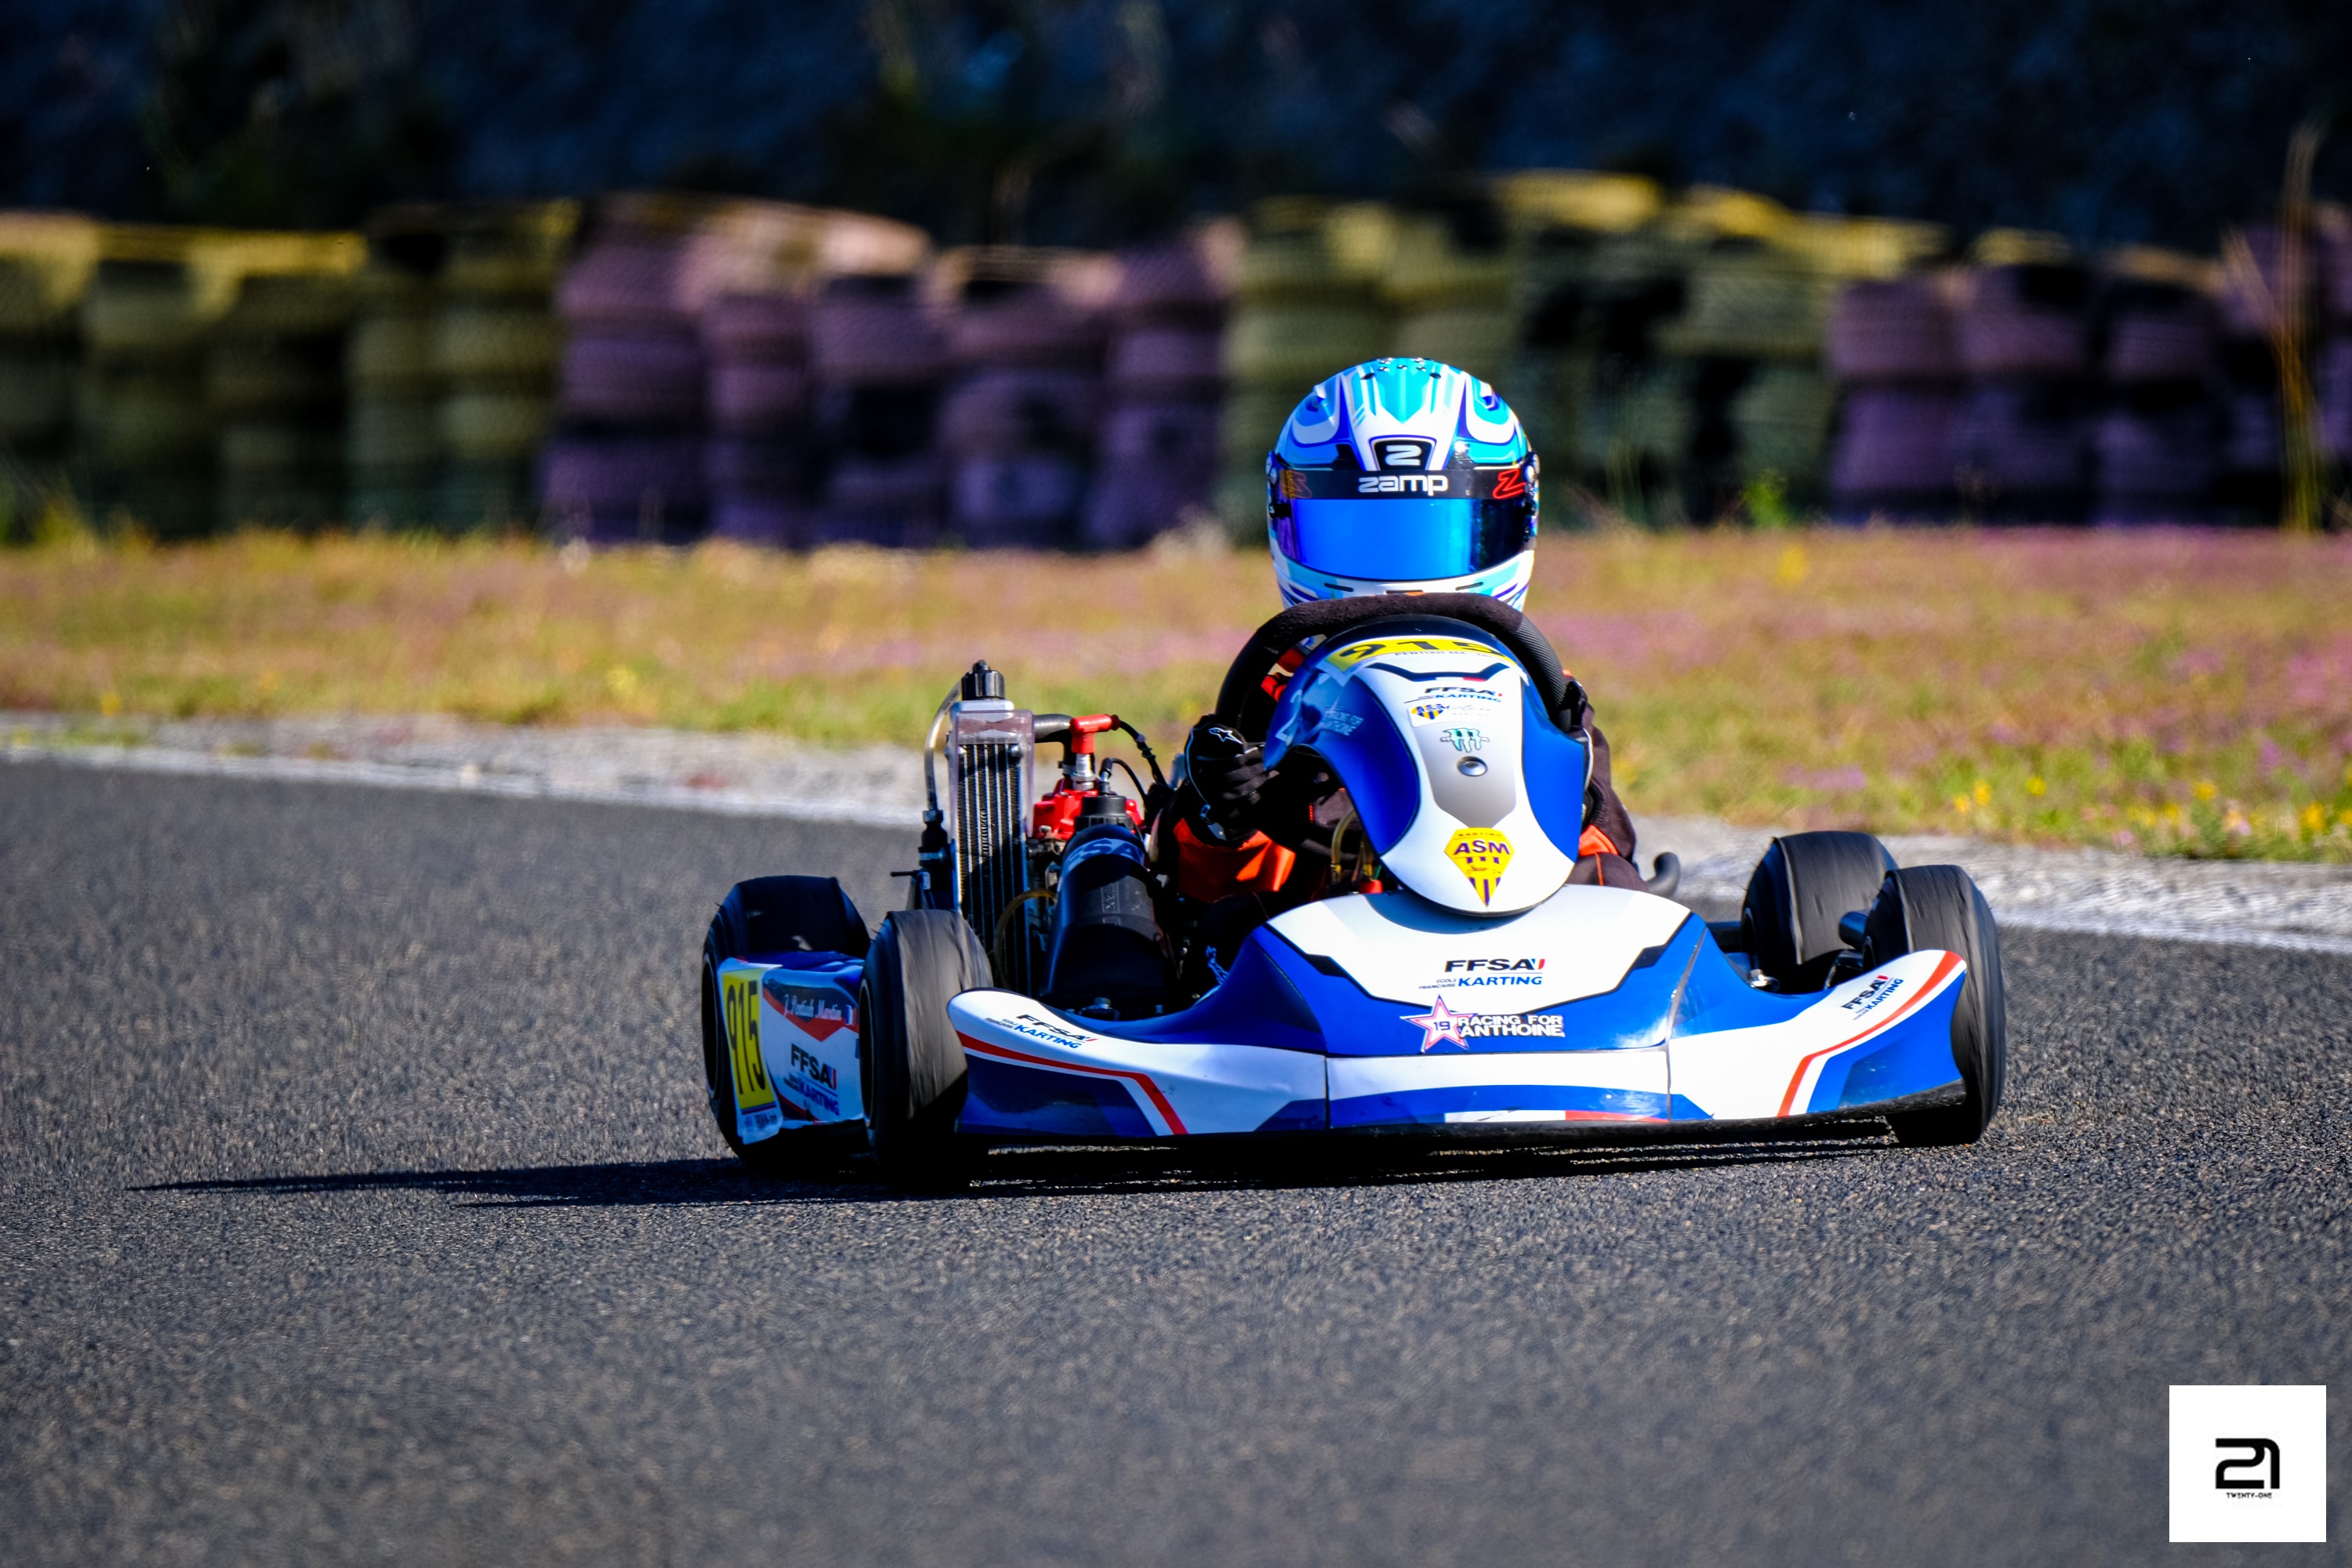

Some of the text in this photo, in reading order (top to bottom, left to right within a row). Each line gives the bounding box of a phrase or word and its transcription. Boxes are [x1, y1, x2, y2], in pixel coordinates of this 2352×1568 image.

[1452, 840, 1511, 855] ASM
[1458, 976, 1543, 987] KARTING
[1864, 978, 1904, 1010] KARTING
[1433, 1021, 1451, 1031] 19
[1457, 1014, 1564, 1026] RACING FOR
[727, 979, 766, 1094] 915
[1014, 1025, 1083, 1049] KARTING
[1459, 1024, 1566, 1038] ANTHOINE
[790, 1042, 833, 1090] FFSA
